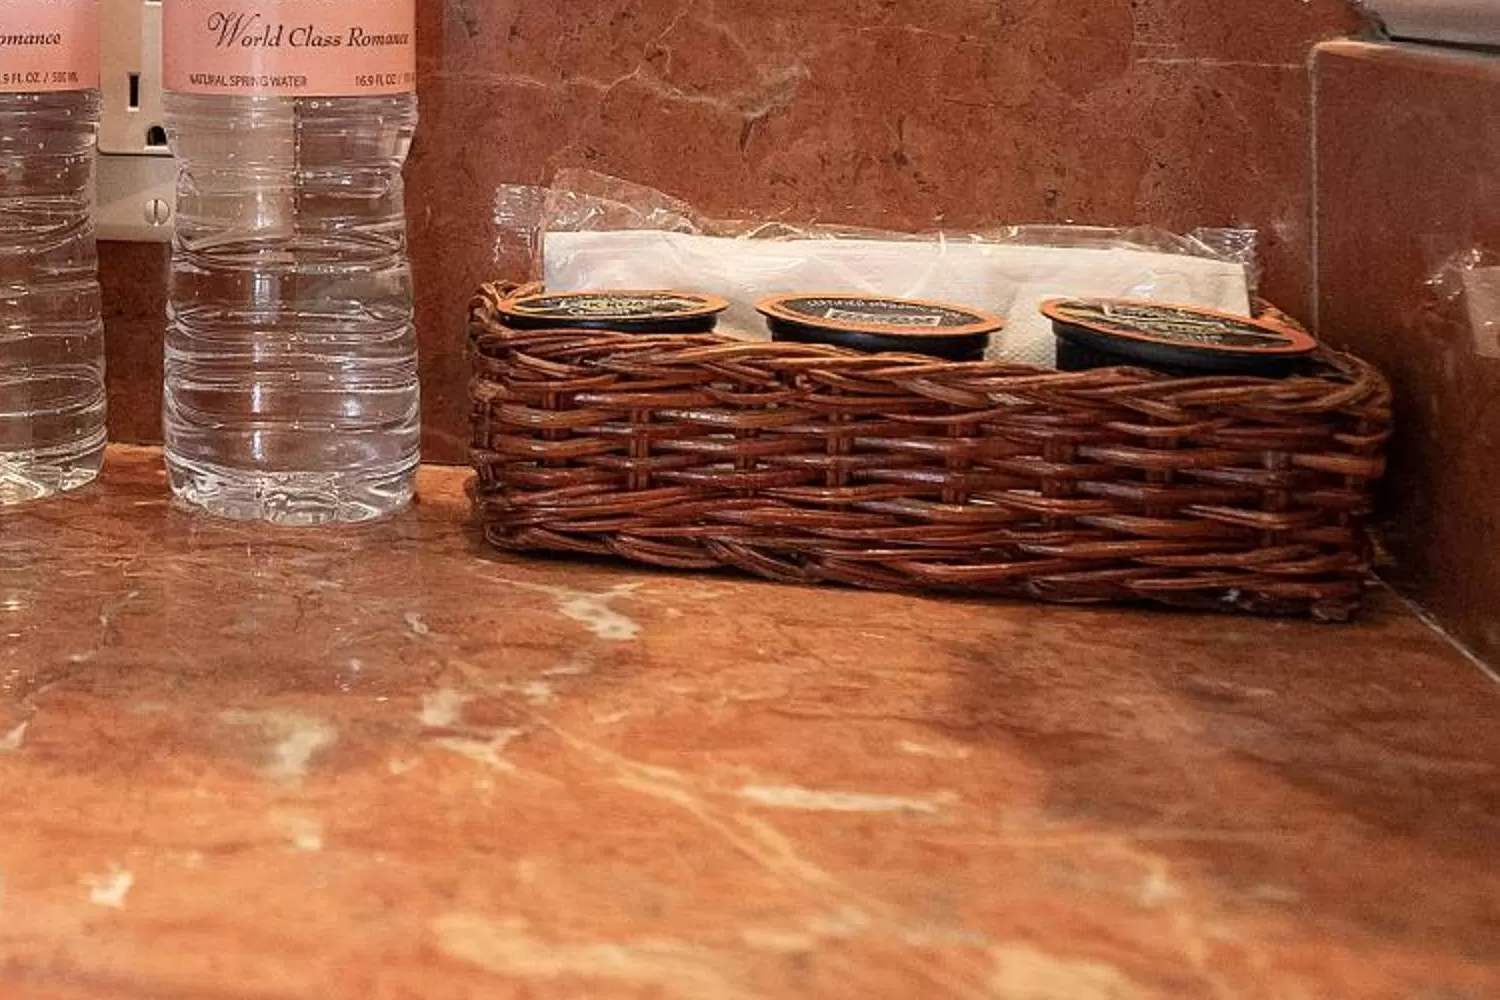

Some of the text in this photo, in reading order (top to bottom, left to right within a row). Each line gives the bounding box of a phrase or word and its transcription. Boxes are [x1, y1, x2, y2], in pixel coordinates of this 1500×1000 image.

[206, 11, 283, 49] World
[288, 24, 343, 48] Class
[269, 74, 308, 88] WATER
